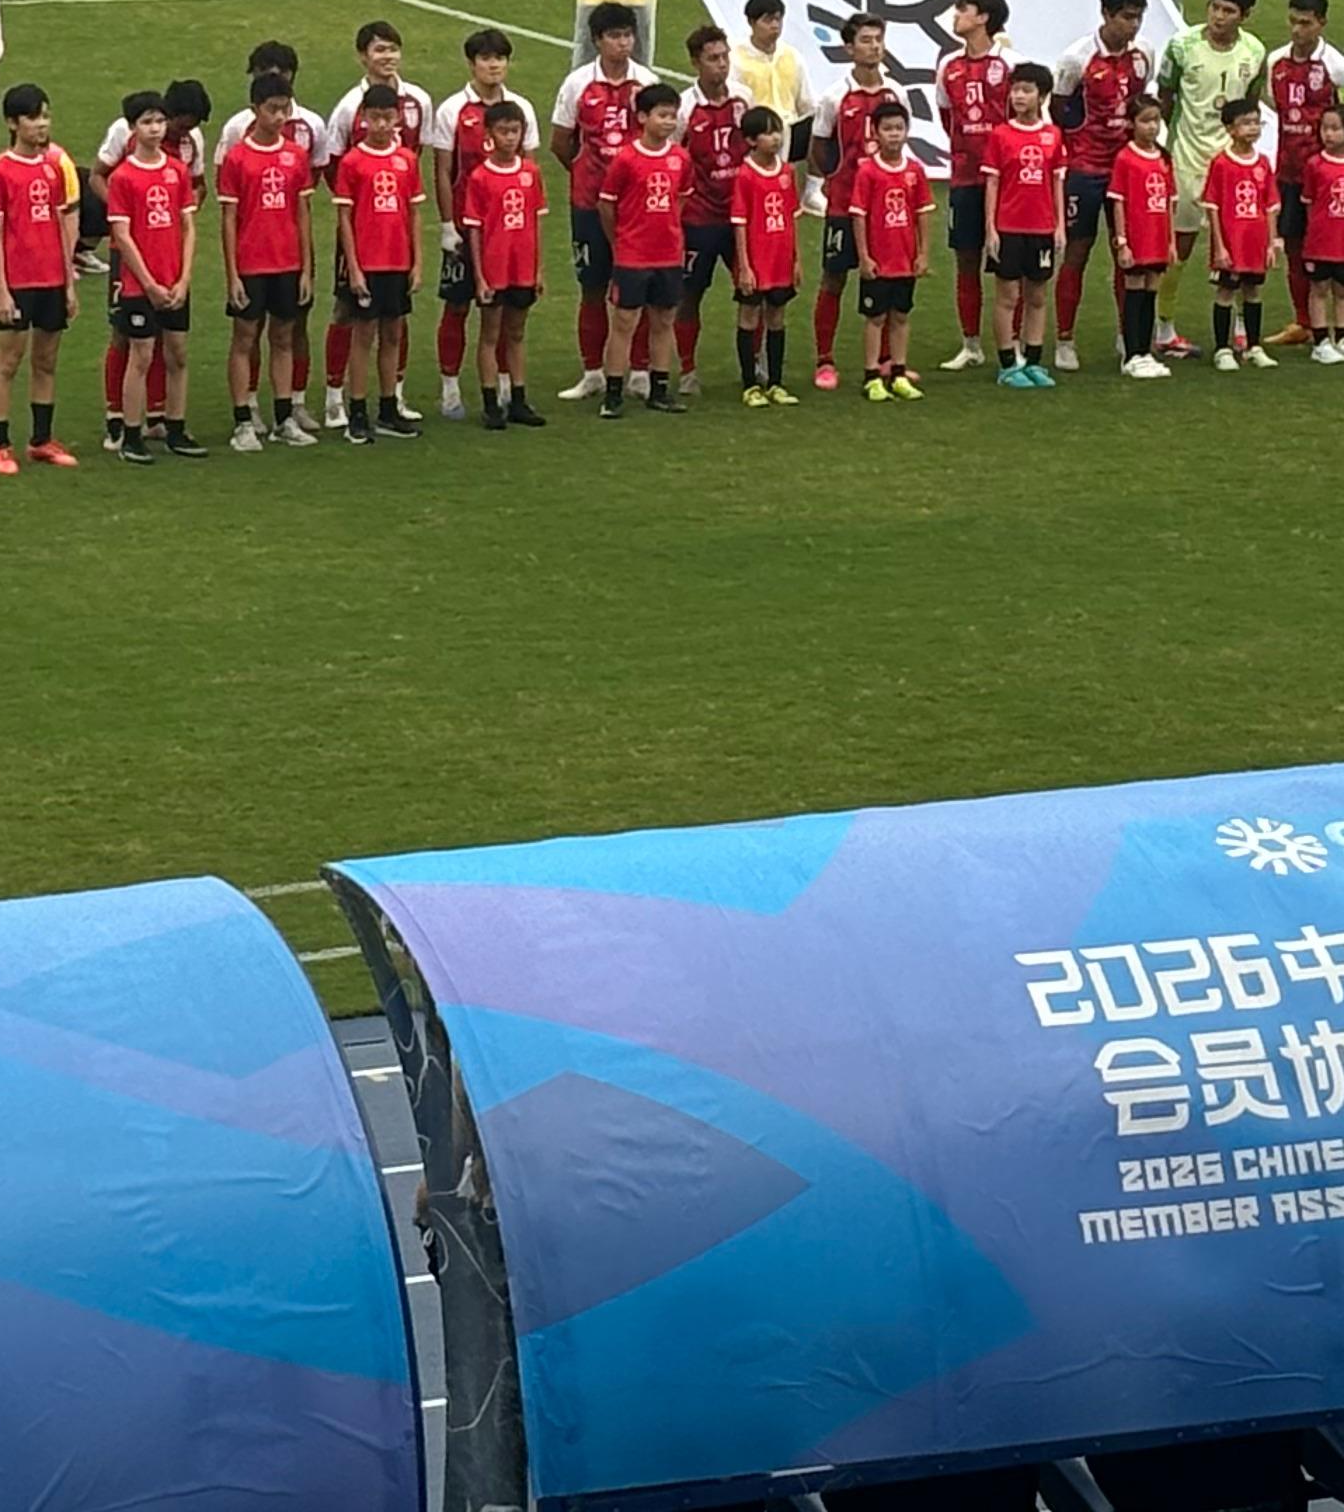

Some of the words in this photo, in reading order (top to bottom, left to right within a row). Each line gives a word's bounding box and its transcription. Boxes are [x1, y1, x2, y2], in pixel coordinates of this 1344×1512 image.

[713, 127, 733, 151] 17
[1118, 1149, 1223, 1193] 2026
[1078, 1196, 1260, 1244] MEMBER
